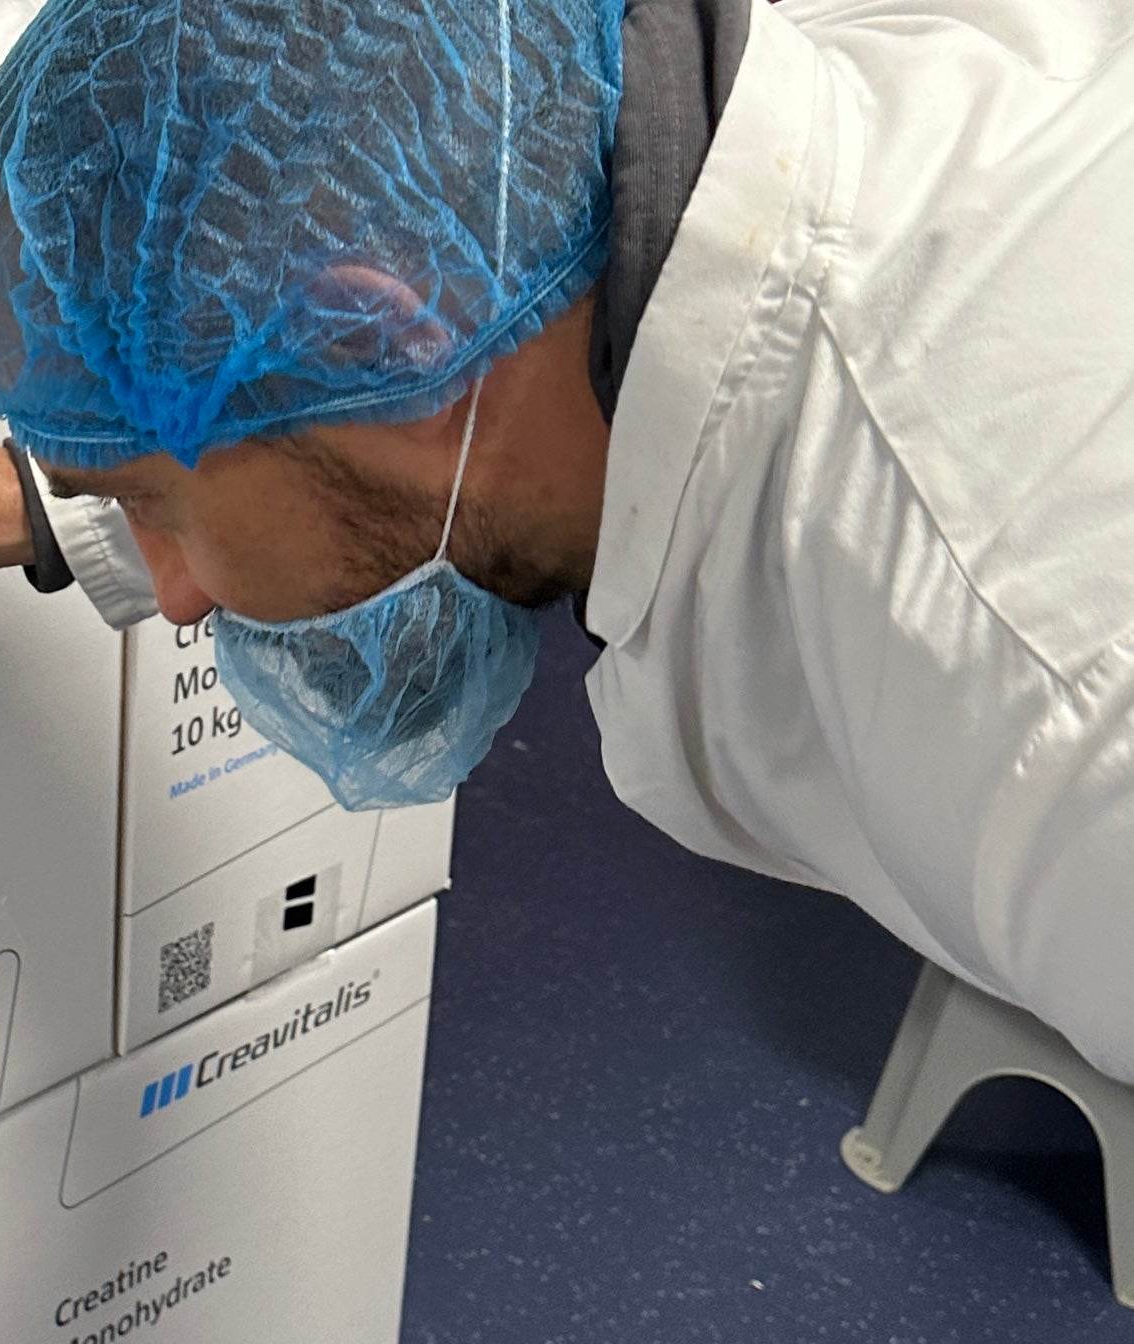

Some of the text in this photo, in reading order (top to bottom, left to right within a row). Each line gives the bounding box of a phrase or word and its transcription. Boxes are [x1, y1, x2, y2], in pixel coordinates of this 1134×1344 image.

[170, 706, 243, 756] 10 kg
[169, 772, 207, 800] Made
[209, 764, 221, 779] in
[54, 1250, 169, 1328] Creatine
